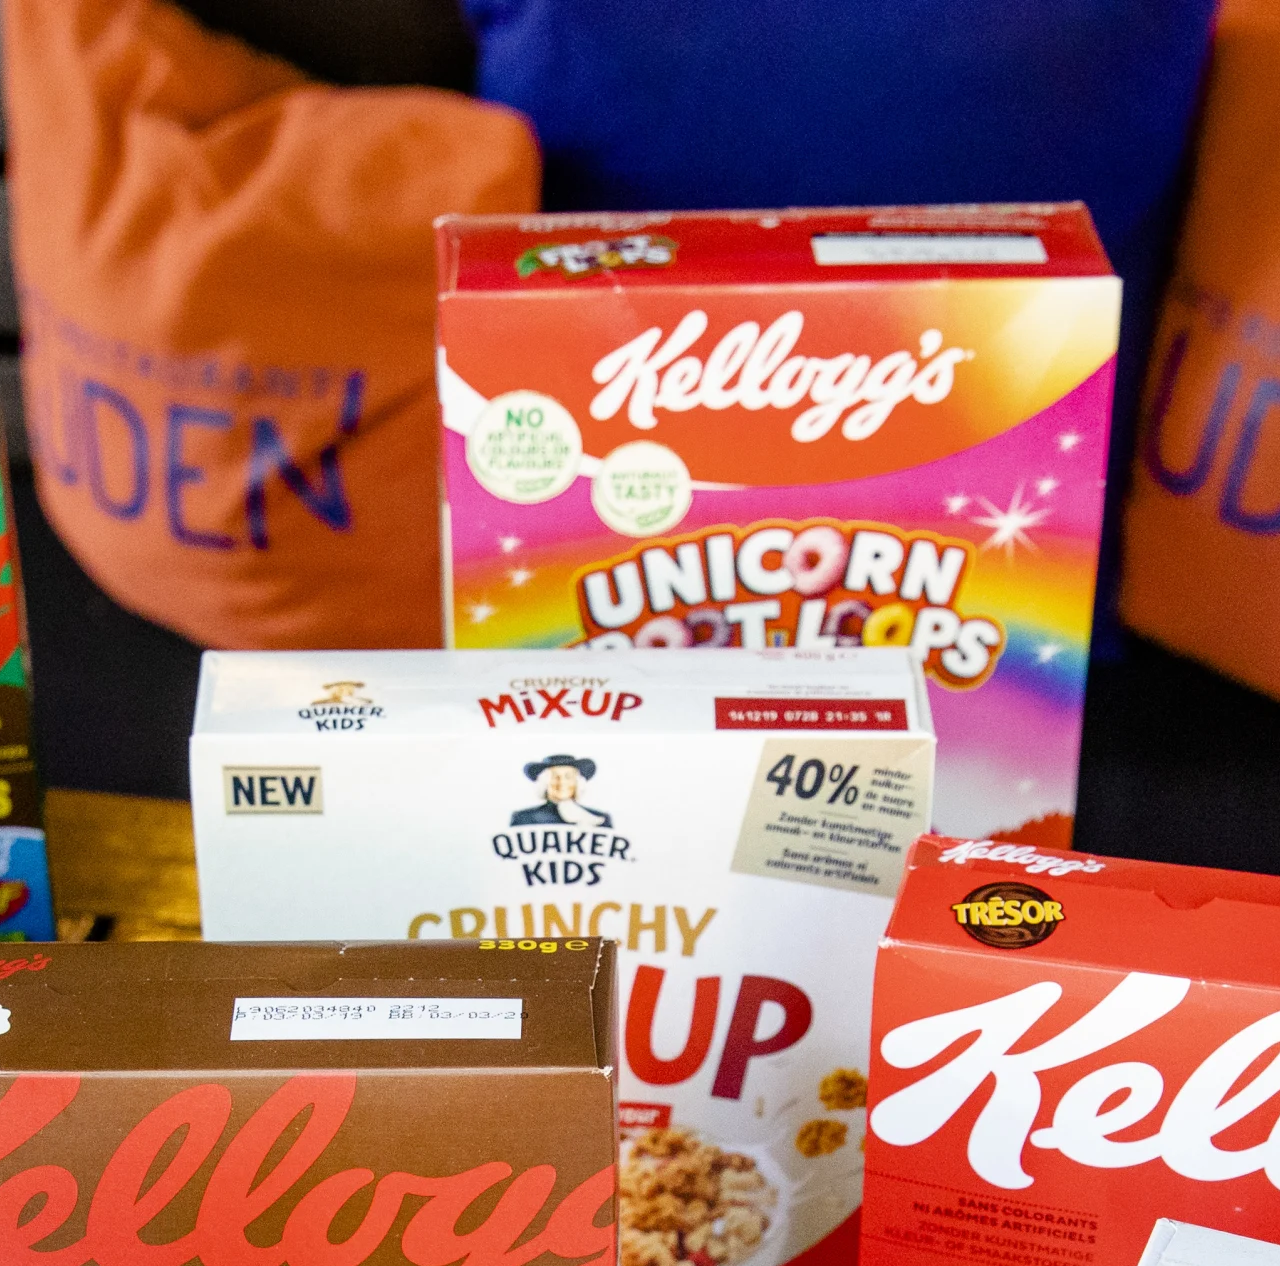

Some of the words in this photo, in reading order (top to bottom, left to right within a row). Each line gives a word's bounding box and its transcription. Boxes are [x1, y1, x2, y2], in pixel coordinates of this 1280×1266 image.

[592, 310, 966, 442] Kellogg's
[506, 407, 544, 429] NO
[580, 525, 965, 628] UNICORN
[509, 676, 613, 691] CRUNCHY
[298, 703, 384, 723] QUAKER
[315, 716, 367, 732] KIDS
[230, 774, 316, 808] NEW
[766, 754, 860, 805] 40%
[493, 829, 631, 862] QUAKER
[938, 840, 1106, 877] Kellogg's
[522, 857, 604, 888] KIDS
[407, 902, 719, 961] CRUNCHY
[478, 938, 559, 955] 330g
[958, 1196, 998, 1214] SANS
[1000, 1203, 1099, 1231] COLORANTS
[1001, 1217, 1097, 1246] ARTIFICIELS
[984, 1232, 1096, 1264] KUNSTMATIGE
